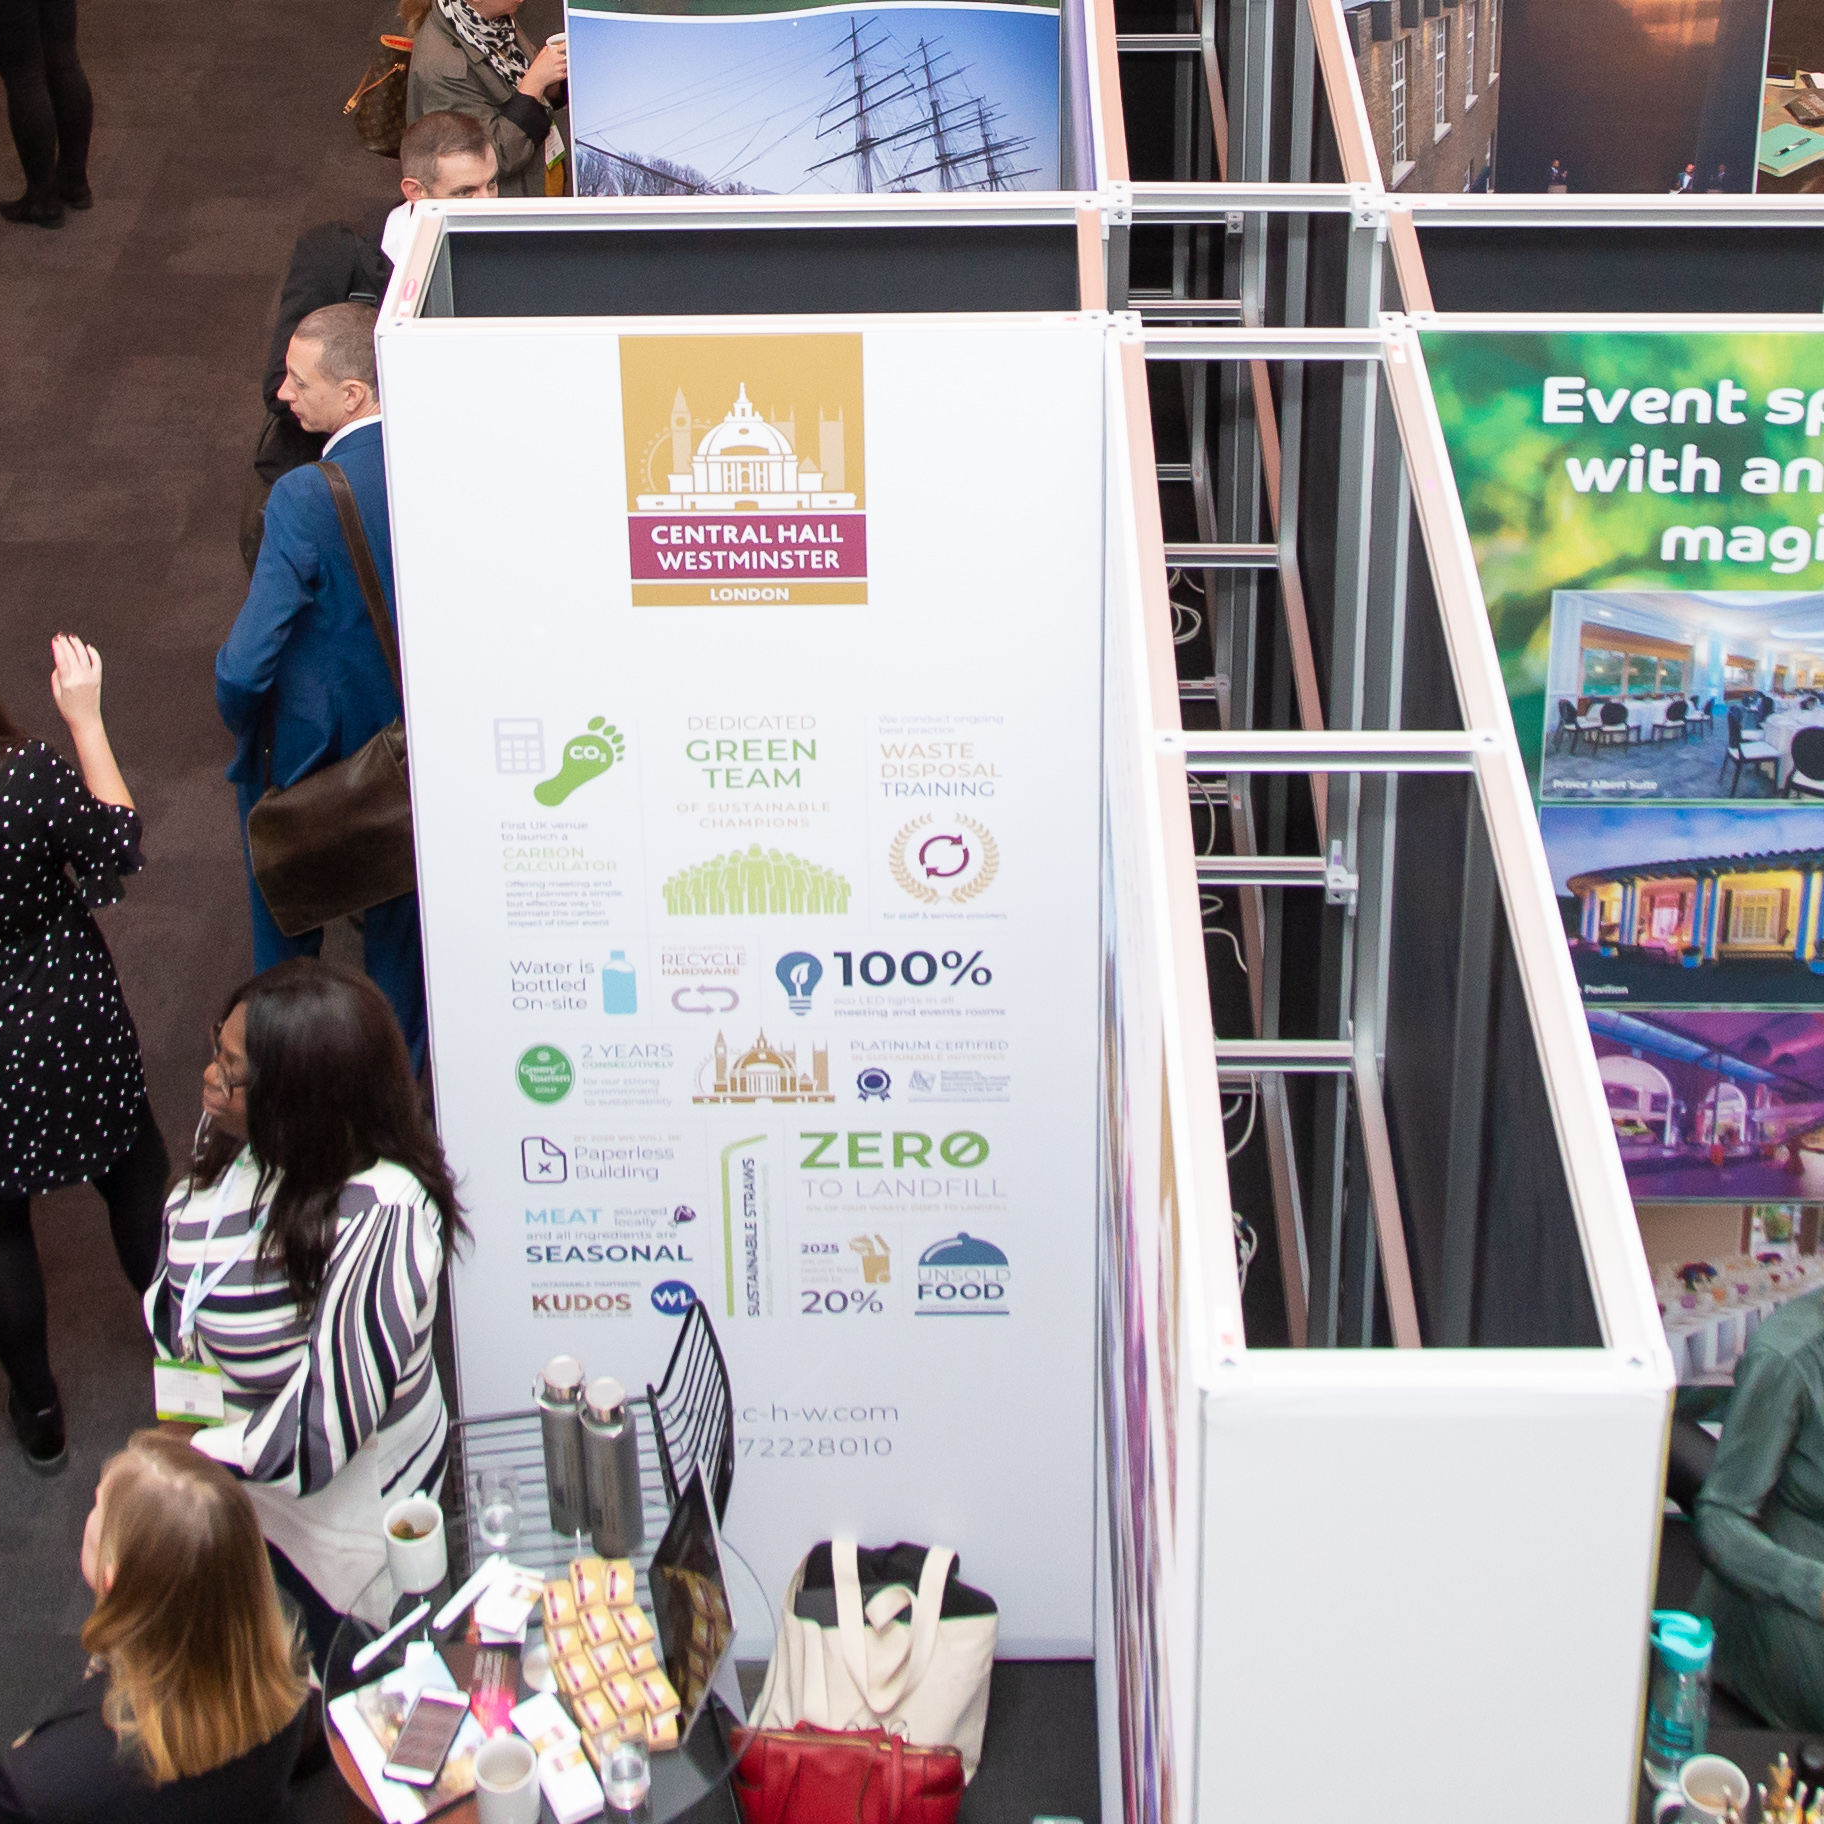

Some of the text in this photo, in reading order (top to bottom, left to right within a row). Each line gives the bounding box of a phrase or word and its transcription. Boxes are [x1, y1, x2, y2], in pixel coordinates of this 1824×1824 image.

[1541, 376, 1746, 426] Event
[1565, 443, 1729, 494] with
[650, 523, 844, 546] CENTRAL HALL
[656, 549, 841, 571] WESTMINSTER
[709, 586, 791, 603] LONDON
[686, 716, 817, 731] DEDICATED
[902, 713, 1004, 727] conduct ongoing
[906, 724, 955, 737] practice
[685, 737, 818, 763] GREEN
[880, 741, 975, 760] WASTE
[880, 762, 1003, 779] DISPOSAL
[701, 768, 803, 790] TEAM
[1552, 778, 1659, 790] Prince Albert Suite
[880, 781, 996, 798] TRAINING
[676, 801, 831, 814] OF SUSTAINABLE
[550, 822, 589, 830] venue
[698, 816, 810, 829] CHAMPIONS
[516, 832, 559, 842] launch
[502, 846, 585, 859] CARBON
[503, 860, 618, 873] CALCULATOR
[509, 959, 595, 975] Water is
[661, 952, 748, 966] RECYCLE
[662, 967, 741, 976] HARDWARE
[832, 949, 993, 988] 100%
[511, 978, 587, 993] bottled
[511, 995, 588, 1011] On-site
[833, 1008, 888, 1018] meeting
[919, 1009, 962, 1017] events
[581, 1043, 674, 1059] 2 YEARS
[849, 1040, 1010, 1052] PLATINUM CERTIFIED
[581, 1060, 675, 1069] CONSECUTIVELY
[574, 1146, 675, 1163] Paperless
[575, 1165, 660, 1181] Building
[801, 1177, 1008, 1199] TO LANDFILL
[526, 1206, 668, 1225] MEAT sourced
[614, 1216, 656, 1228] locally
[526, 1230, 652, 1242] and all ingredients
[741, 1157, 760, 1318] SUSTAINABLE STRAWS
[525, 1244, 693, 1263] SEASONAL
[800, 1242, 840, 1255] 2025
[917, 1268, 1012, 1282] UNSOLD
[917, 1283, 1005, 1300] FOOD
[531, 1293, 632, 1312] KUDOS
[800, 1289, 884, 1314] 20%
